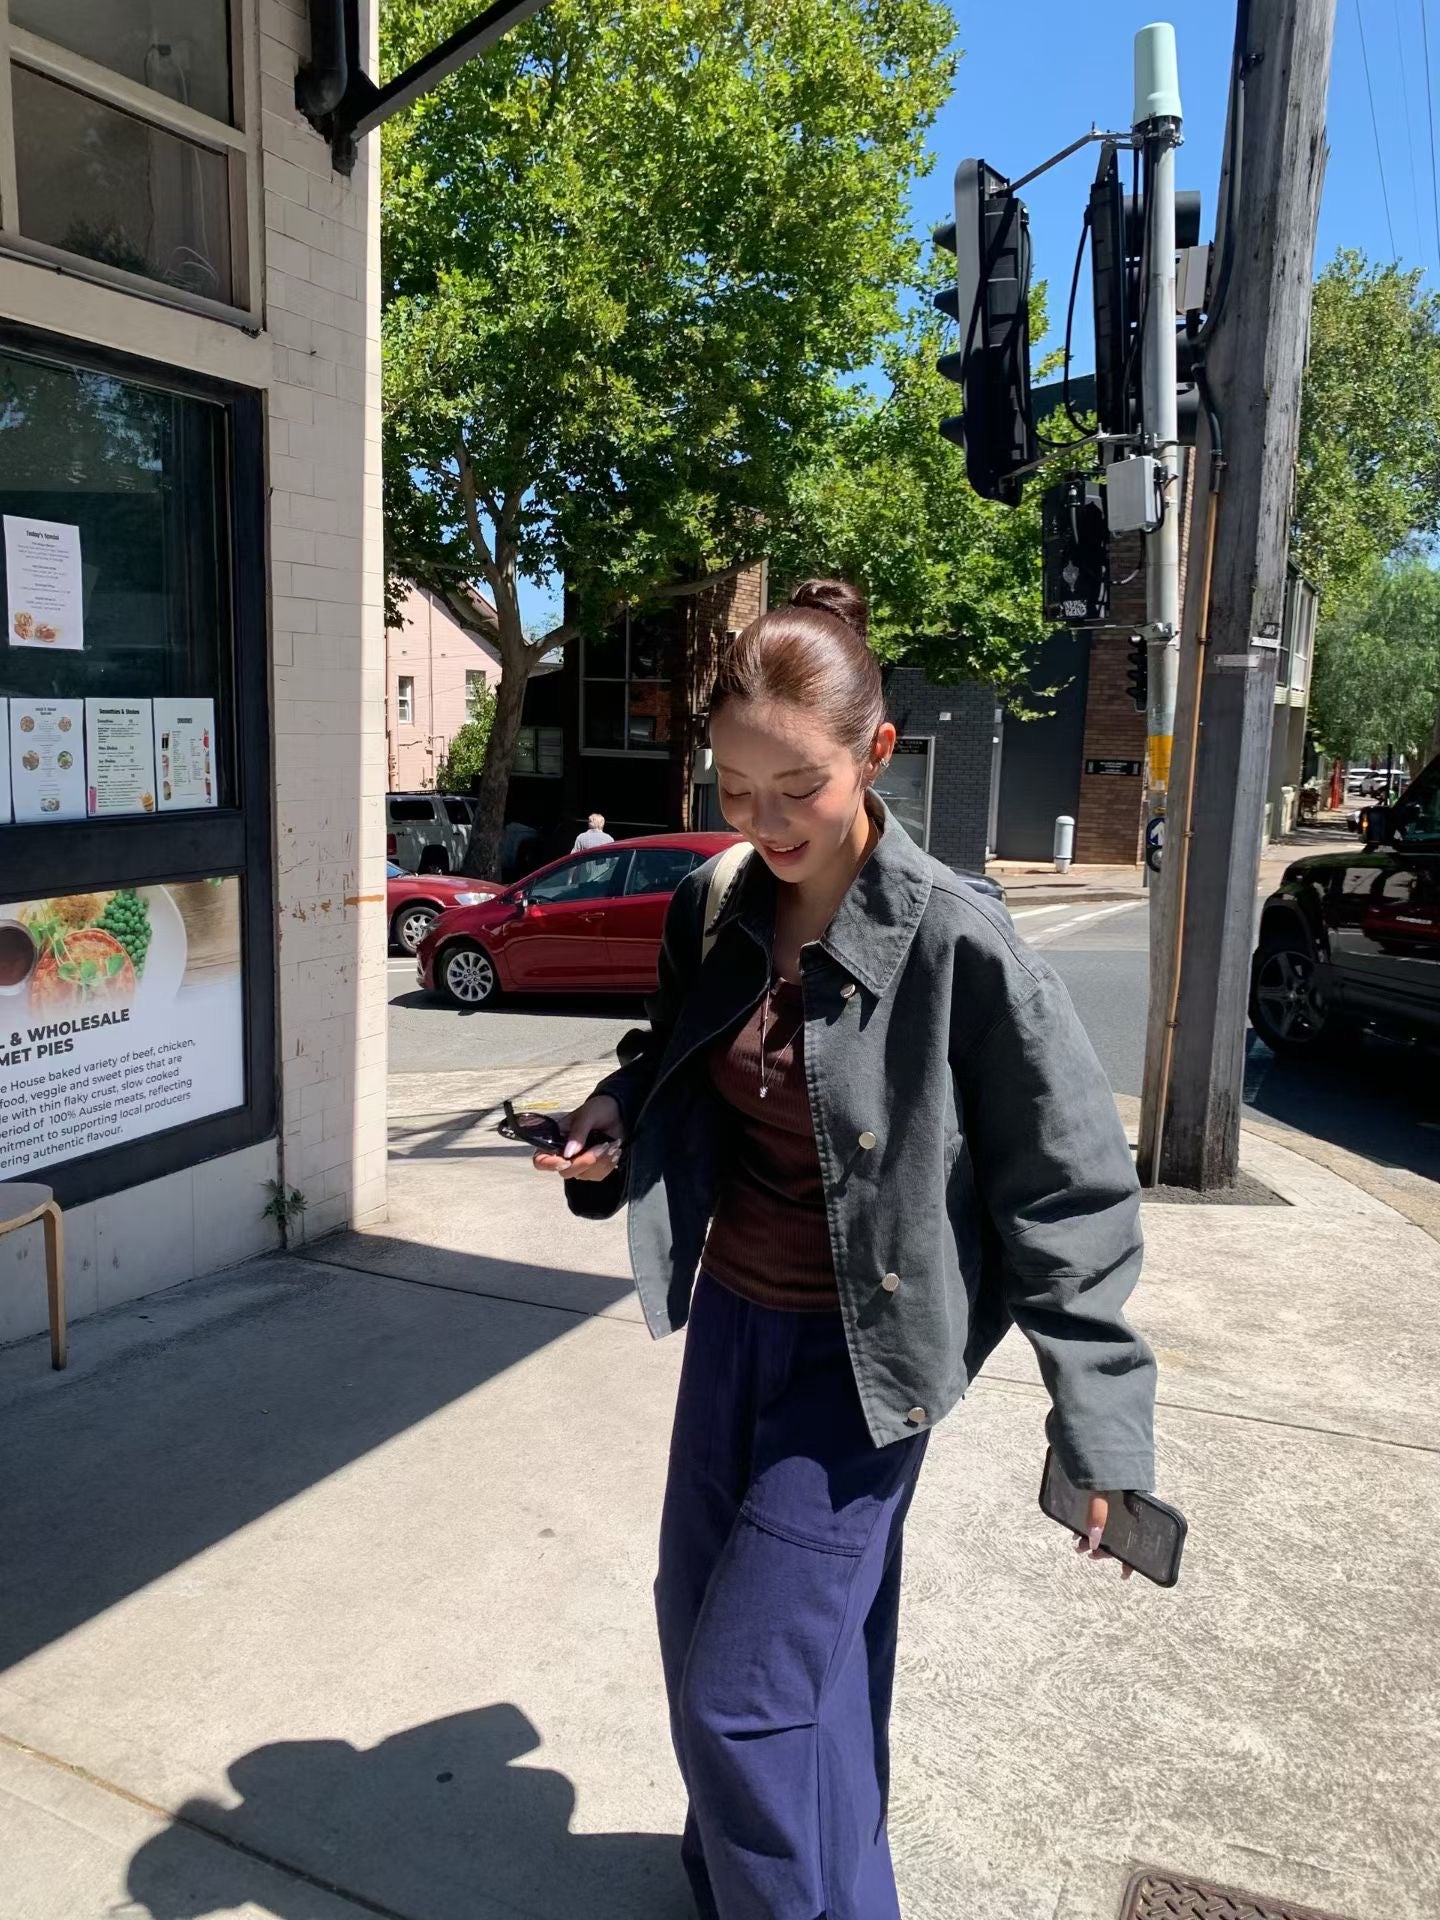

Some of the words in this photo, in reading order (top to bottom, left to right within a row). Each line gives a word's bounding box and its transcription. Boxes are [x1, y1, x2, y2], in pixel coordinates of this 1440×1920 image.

[10, 1032, 22, 1047] &
[27, 1008, 130, 1042] WHOLESALE
[37, 1038, 74, 1059] PIES
[10, 1076, 46, 1091] House
[48, 1065, 81, 1081] baked
[84, 1057, 118, 1073] variety
[120, 1052, 130, 1063] of
[132, 1047, 156, 1060] beef,
[158, 1039, 196, 1054] chicken,
[30, 1084, 67, 1101] veggie
[70, 1078, 89, 1090] and
[92, 1069, 122, 1085] sweet
[124, 1064, 144, 1078] pies
[146, 1058, 165, 1070] that
[168, 1055, 182, 1064] are
[0, 1122, 30, 1138] eriod
[33, 1118, 44, 1129] of
[50, 1110, 76, 1124] 100%
[79, 1101, 112, 1116] Aussie
[114, 1091, 146, 1106] meats,
[149, 1078, 192, 1096] reflecting
[12, 1107, 37, 1121] with
[40, 1100, 61, 1113] thin
[64, 1094, 88, 1106] flaky
[91, 1086, 119, 1099] crust,
[121, 1080, 143, 1091] slow
[146, 1067, 179, 1084] cooked
[48, 1131, 58, 1140] to
[61, 1114, 117, 1136] supporting
[120, 1104, 142, 1118] local
[144, 1092, 191, 1111] producers
[33, 1137, 84, 1159] authentic
[87, 1127, 123, 1143] flavour.
